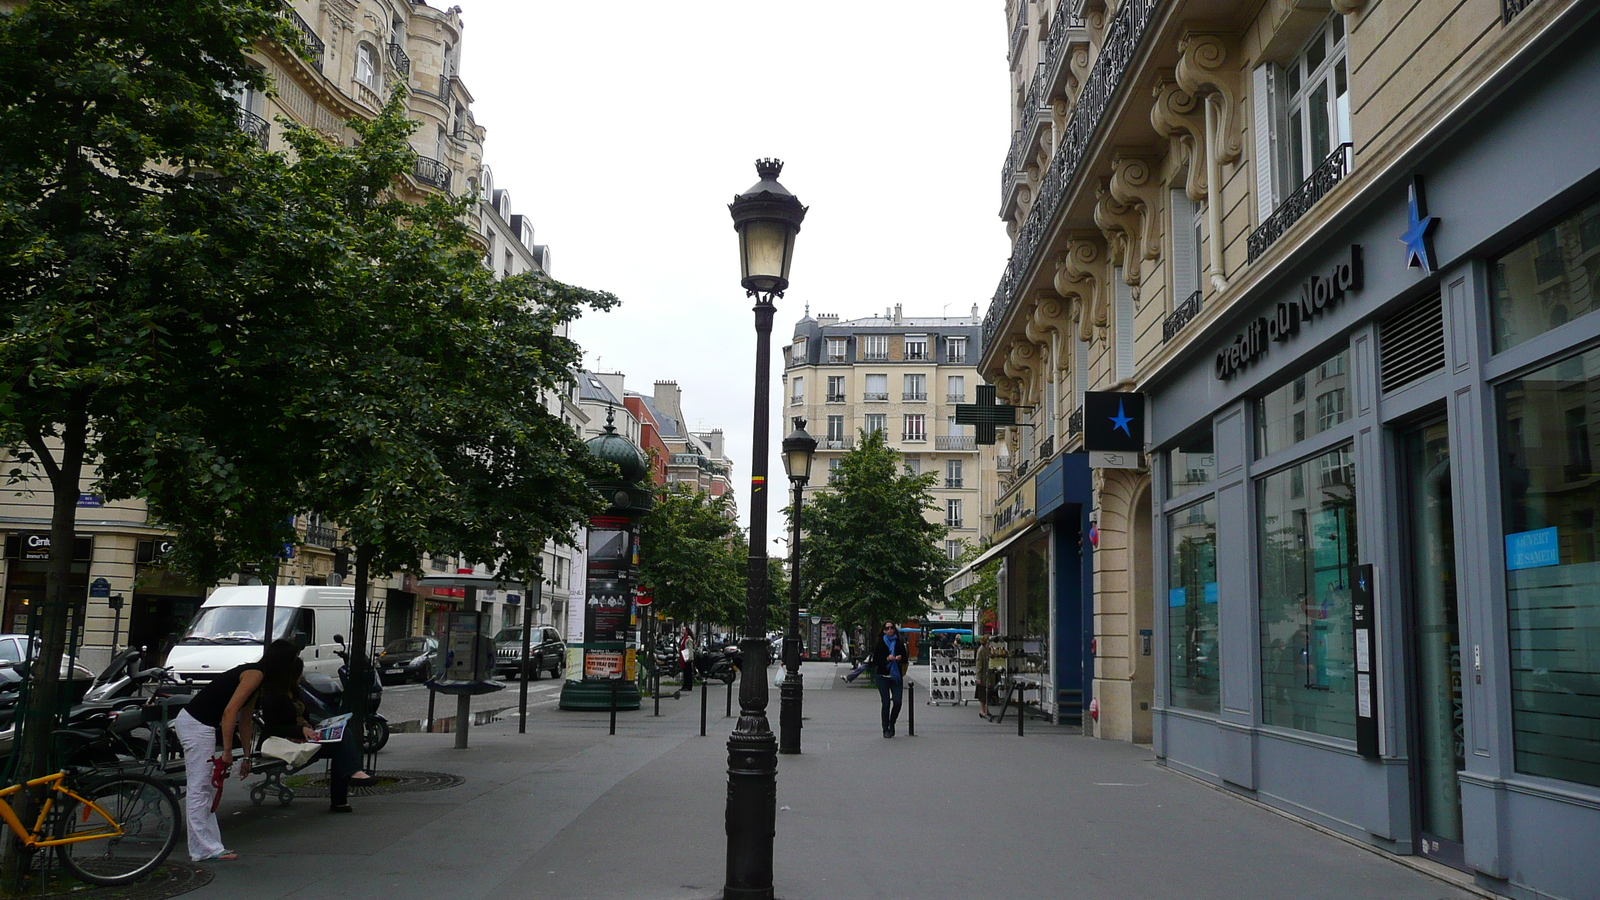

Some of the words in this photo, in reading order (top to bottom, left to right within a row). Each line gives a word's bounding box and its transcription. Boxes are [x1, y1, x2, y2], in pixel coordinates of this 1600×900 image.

[1214, 317, 1268, 381] Crédit
[1268, 302, 1298, 342] du
[1300, 244, 1365, 322] Nord
[1516, 531, 1550, 548] OUVERT
[1513, 553, 1523, 566] LE
[1524, 548, 1556, 564] SAMEDI
